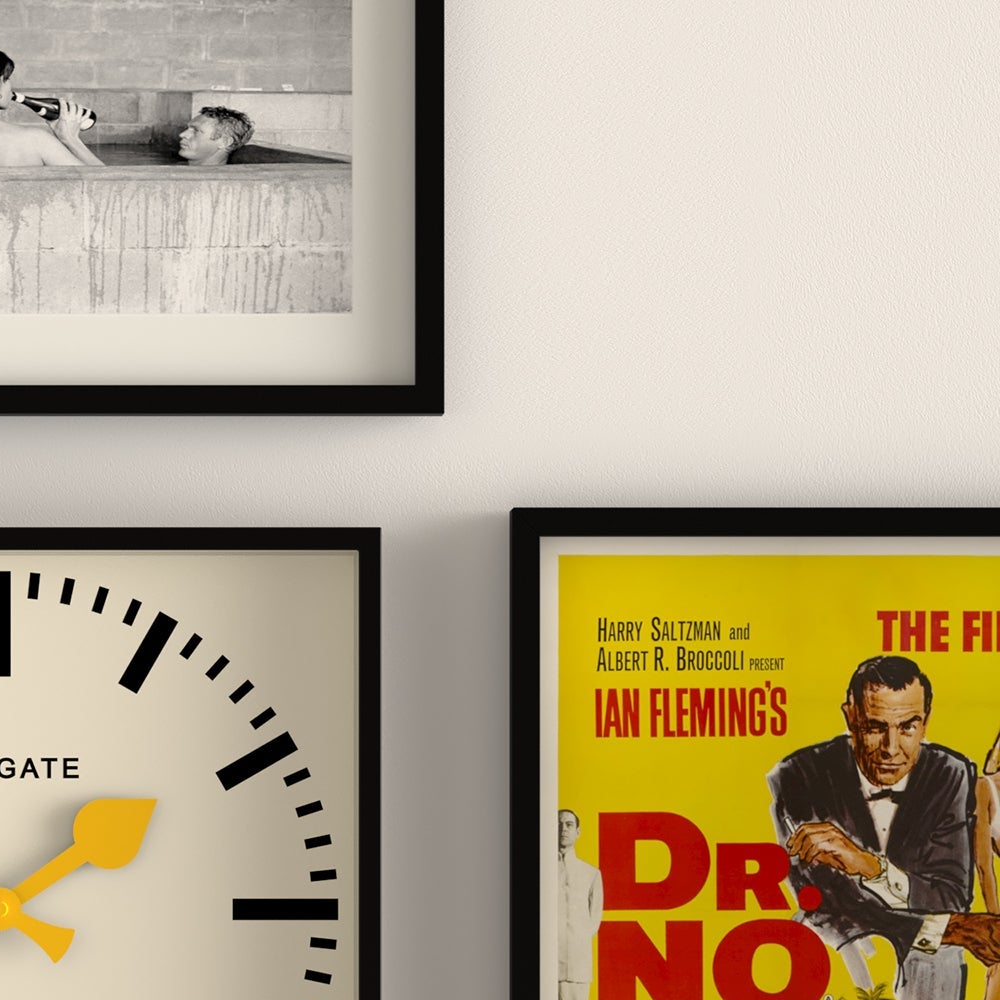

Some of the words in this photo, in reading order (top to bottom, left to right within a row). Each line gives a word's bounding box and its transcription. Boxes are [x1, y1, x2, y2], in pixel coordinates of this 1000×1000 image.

[597, 617, 643, 642] HARRY
[651, 616, 721, 641] SALTZMAN
[729, 622, 750, 640] and
[876, 610, 949, 652] THE
[596, 646, 649, 671] ALBERT
[654, 646, 669, 671] R.
[676, 646, 744, 671] BROCCOLI
[749, 657, 785, 671] PRESENT
[595, 688, 640, 738] IAN
[650, 680, 787, 738] FLEMING'S
[597, 812, 823, 912] DR.
